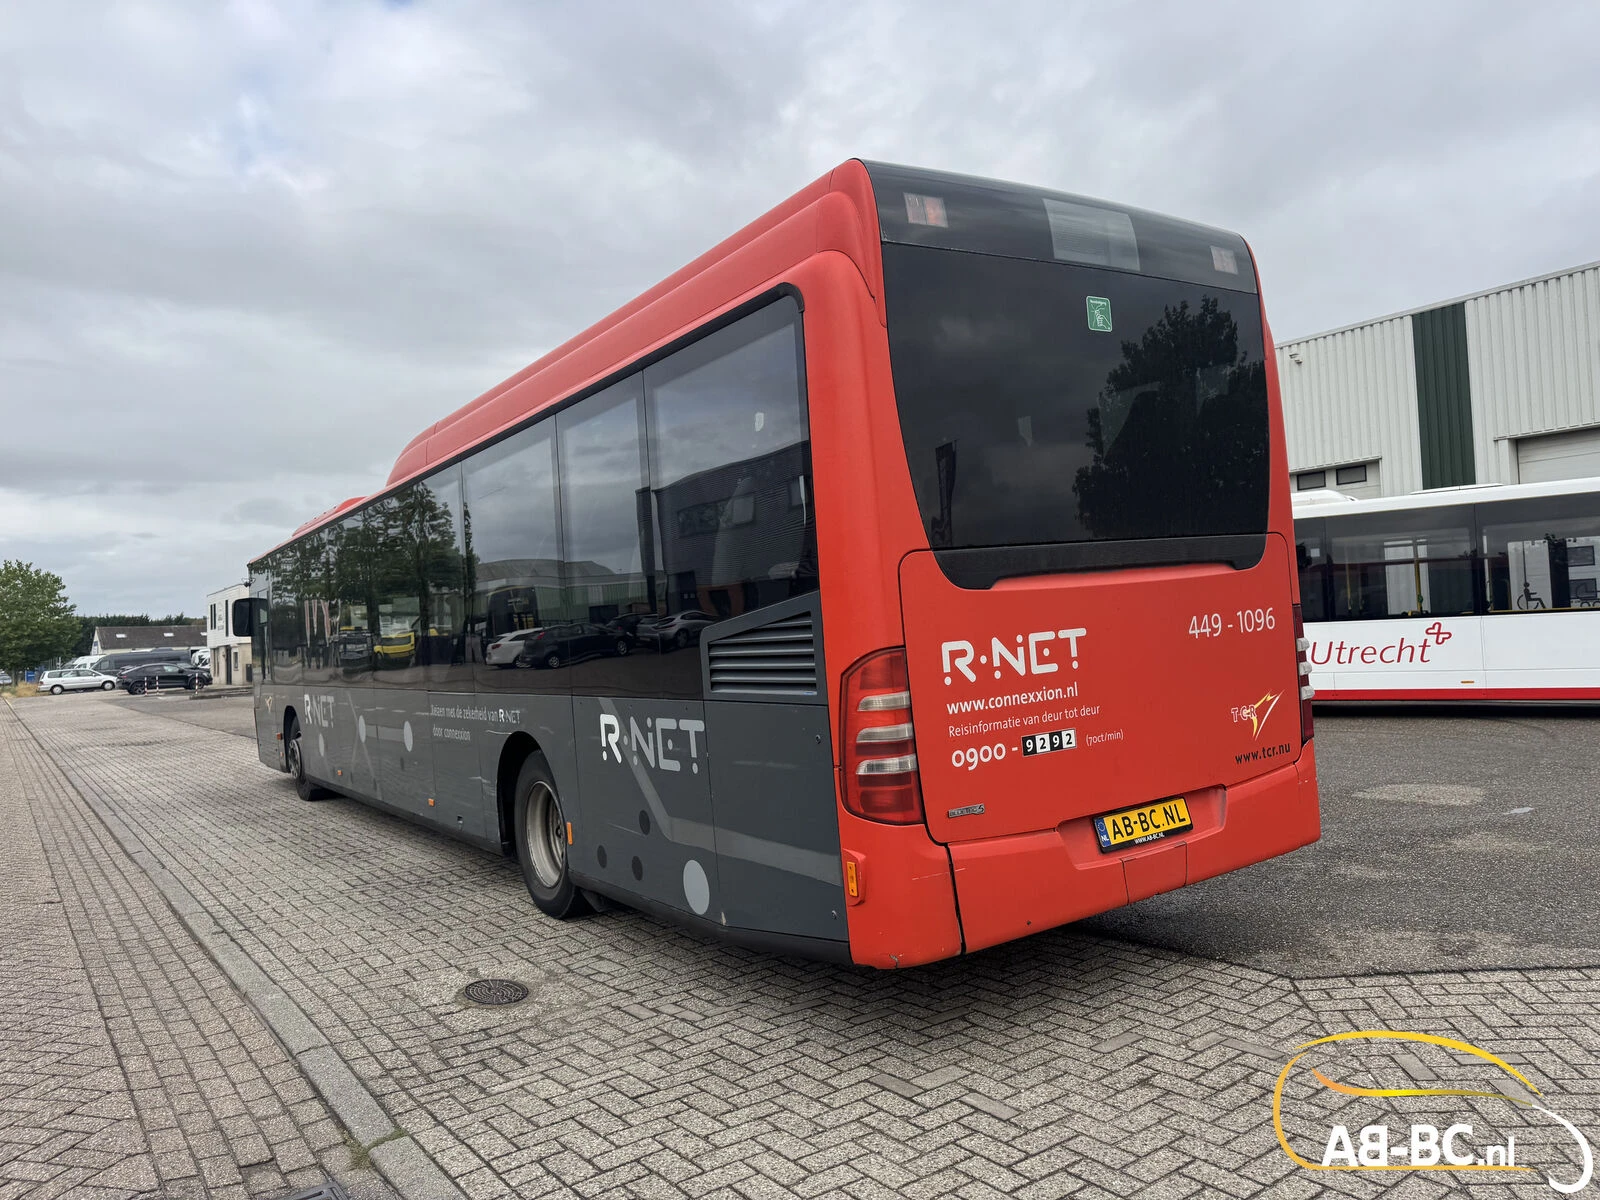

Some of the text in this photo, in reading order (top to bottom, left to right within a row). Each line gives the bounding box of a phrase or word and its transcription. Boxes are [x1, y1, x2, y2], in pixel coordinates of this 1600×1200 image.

[1188, 613, 1222, 639] 449
[1236, 607, 1276, 633] 1096
[1311, 637, 1432, 665] Utrecht
[946, 681, 1079, 716] www.connexxion.nl
[1231, 704, 1258, 723] TCR
[949, 704, 1101, 738] Reisinformatie van deur tot deur
[951, 743, 1006, 771] 0900
[1025, 733, 1073, 752] 9292
[1085, 729, 1124, 746] (70ct/min)
[1235, 743, 1291, 764] www.tcr.nu
[1111, 803, 1187, 840] AB-BC.NL
[1101, 834, 1110, 842] NL
